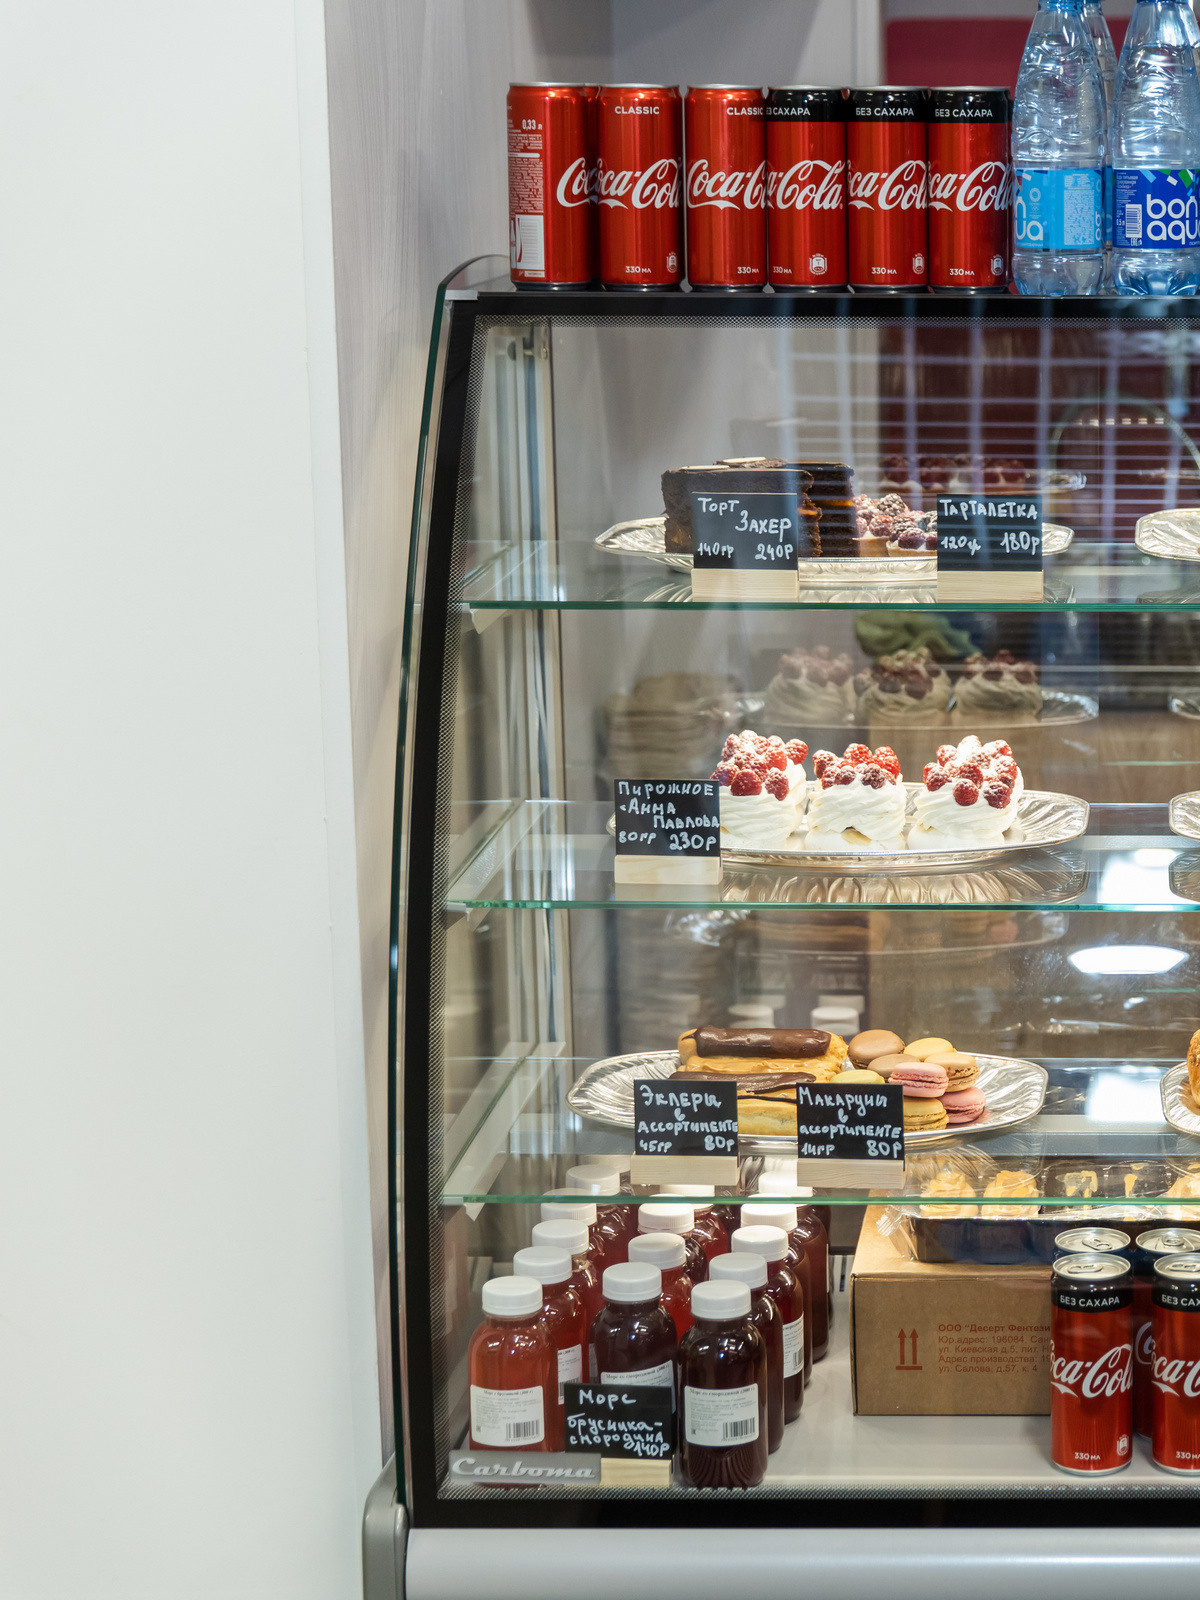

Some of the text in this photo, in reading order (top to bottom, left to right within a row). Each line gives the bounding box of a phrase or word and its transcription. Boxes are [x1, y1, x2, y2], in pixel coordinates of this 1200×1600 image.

[614, 106, 660, 115] CLASSIC
[726, 107, 764, 116] CLASSIC
[772, 107, 811, 116] САХАРА
[856, 107, 914, 116] БЕЗ САХАРА
[934, 108, 993, 118] БЕЗ САХАРА
[1146, 194, 1198, 220] bon
[1059, 1294, 1120, 1307] БЕЗ САХАРА
[1161, 1294, 1178, 1306] БЕЗ
[938, 1324, 962, 1332] ООО
[1030, 1336, 1050, 1344] Сан
[954, 1346, 998, 1354] Киевская
[938, 1355, 968, 1364] Адрес
[970, 1356, 1038, 1364] производства:
[1032, 1364, 1038, 1372] 4
[579, 1388, 637, 1410] Морс
[452, 1458, 596, 1478] Carboma
